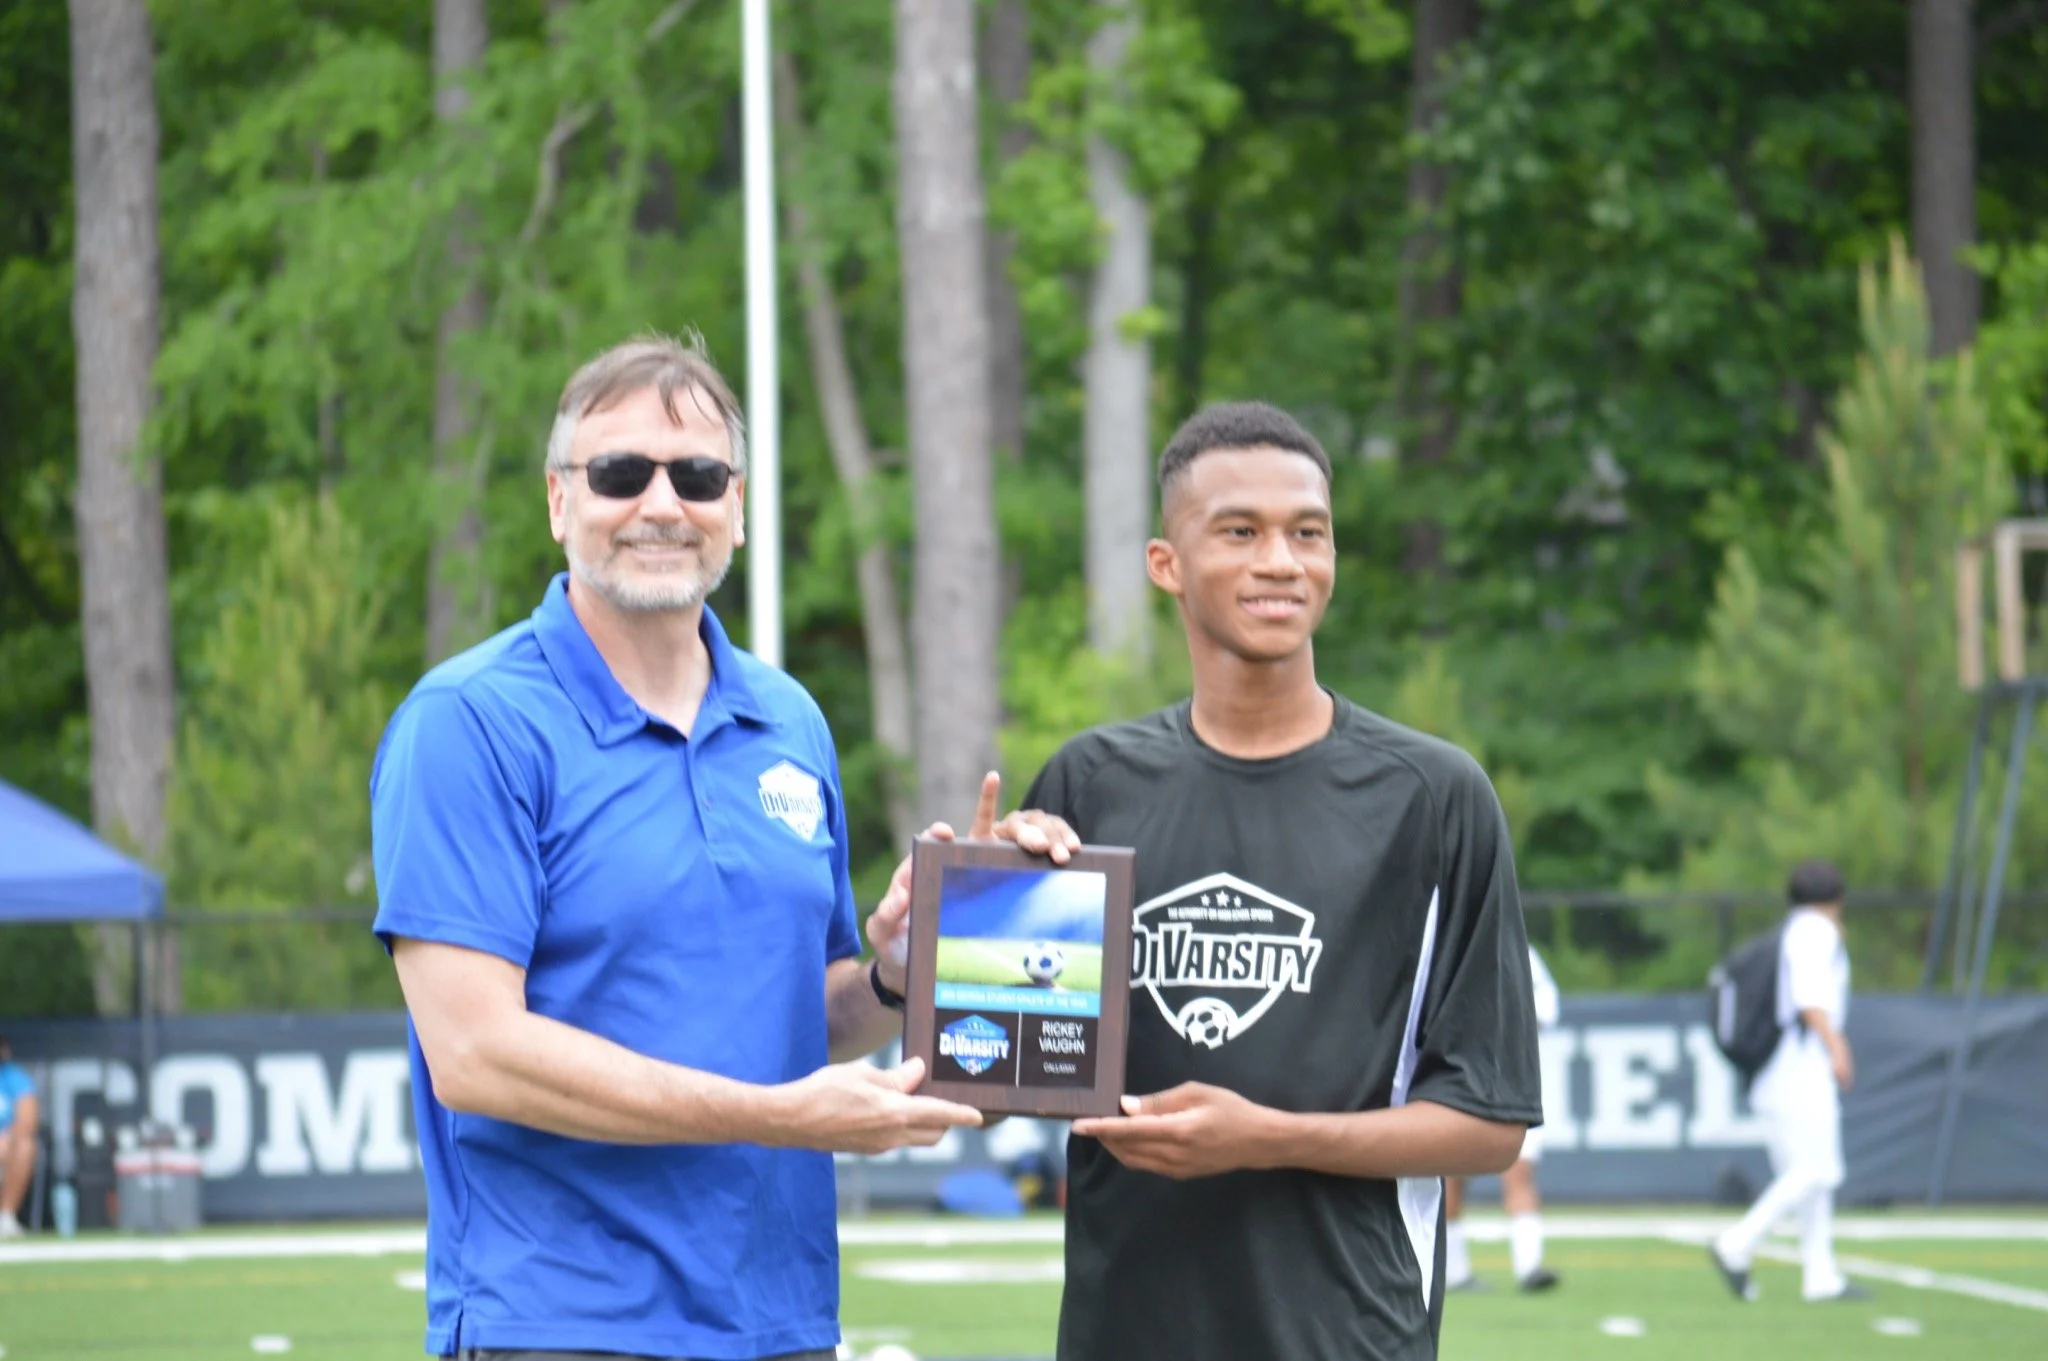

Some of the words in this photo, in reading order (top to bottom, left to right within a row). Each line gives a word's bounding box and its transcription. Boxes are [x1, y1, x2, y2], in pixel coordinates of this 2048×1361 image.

[1042, 1020, 1084, 1038] RICKEY
[1038, 1036, 1086, 1055] VAUGHN
[50, 1051, 424, 1178] COM
